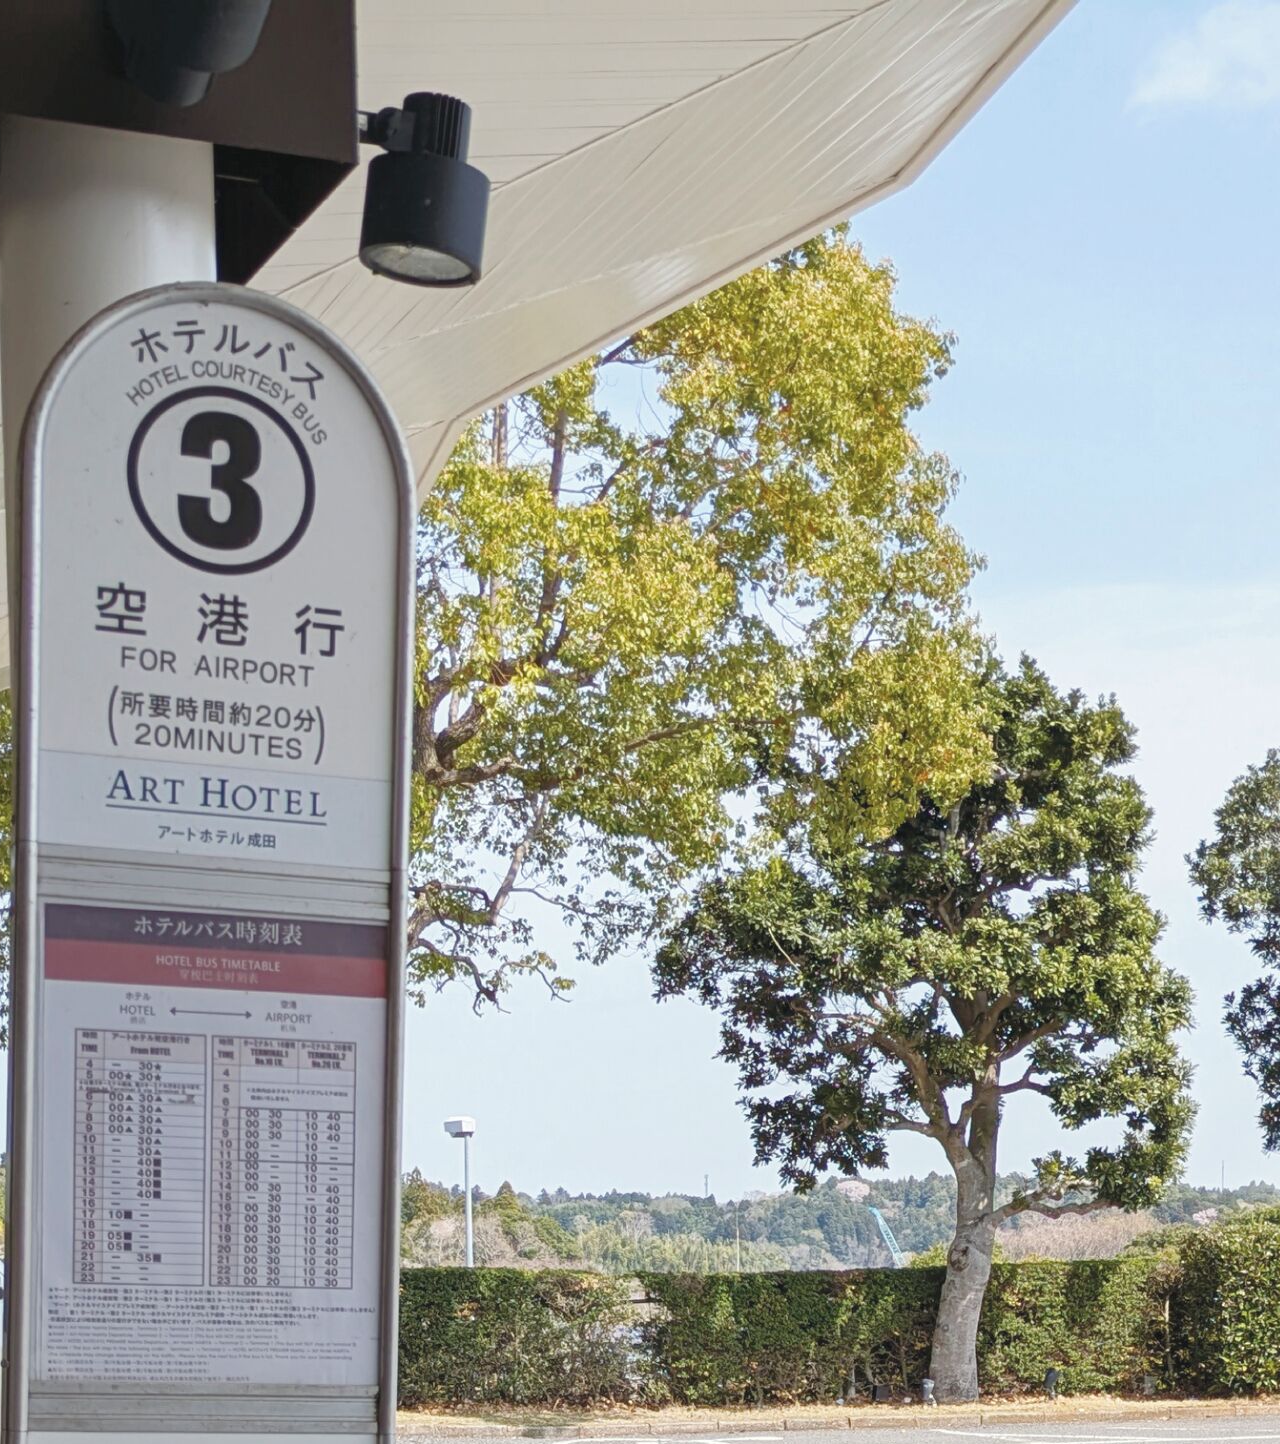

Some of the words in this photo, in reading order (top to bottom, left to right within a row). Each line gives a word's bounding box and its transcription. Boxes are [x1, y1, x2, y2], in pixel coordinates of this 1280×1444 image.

[131, 320, 325, 401] ホテルバス
[125, 365, 189, 408] HOTEL
[193, 360, 292, 404] COURTESY
[292, 402, 327, 446] BUS
[177, 411, 263, 550] 3
[121, 647, 176, 673] FOR
[195, 655, 314, 687] AIRPORT
[134, 724, 303, 760] 20MINUTES
[106, 770, 184, 804] ART
[200, 778, 327, 817] HOTEL
[158, 825, 276, 848] アートホテル成田
[134, 916, 303, 946] ホテルバス時刻表
[156, 955, 192, 967] HOTEL
[196, 957, 217, 969] BUS
[222, 959, 280, 971] TIMETABLE
[126, 992, 151, 1001] ホテル
[120, 1005, 155, 1016] HOTEL
[266, 1012, 312, 1024] AIRPORT
[139, 1062, 152, 1070] 30
[109, 1072, 123, 1080] 00
[139, 1073, 152, 1081] 30
[109, 1104, 123, 1112] 00
[109, 1115, 123, 1123] 00
[139, 1116, 153, 1124] 30
[269, 1111, 282, 1119] 30
[306, 1113, 317, 1121] 10
[269, 1121, 282, 1129] 30
[306, 1123, 317, 1131] 10
[327, 1124, 340, 1132] 40
[246, 1131, 259, 1139] 00
[269, 1132, 282, 1140] 30
[305, 1133, 317, 1141] 10
[327, 1134, 340, 1142] 40
[245, 1141, 259, 1149] 00
[305, 1144, 317, 1152] 10
[138, 1148, 152, 1156] 30
[245, 1152, 258, 1160] 00
[305, 1154, 317, 1162] 10
[137, 1169, 152, 1177] 40
[137, 1180, 151, 1188] 40
[305, 1175, 317, 1183] 10
[245, 1183, 258, 1191] 00
[268, 1184, 281, 1192] 30
[245, 1204, 258, 1212] 00
[268, 1205, 281, 1213] 30
[305, 1206, 316, 1214] 10
[109, 1211, 122, 1219] 10
[245, 1215, 258, 1223] 00
[325, 1217, 339, 1225] 40
[245, 1225, 258, 1233] 00
[267, 1226, 280, 1234] 30
[304, 1227, 316, 1235] 10
[108, 1232, 122, 1240] 05
[137, 1254, 151, 1262] 35
[267, 1278, 279, 1286] 20
